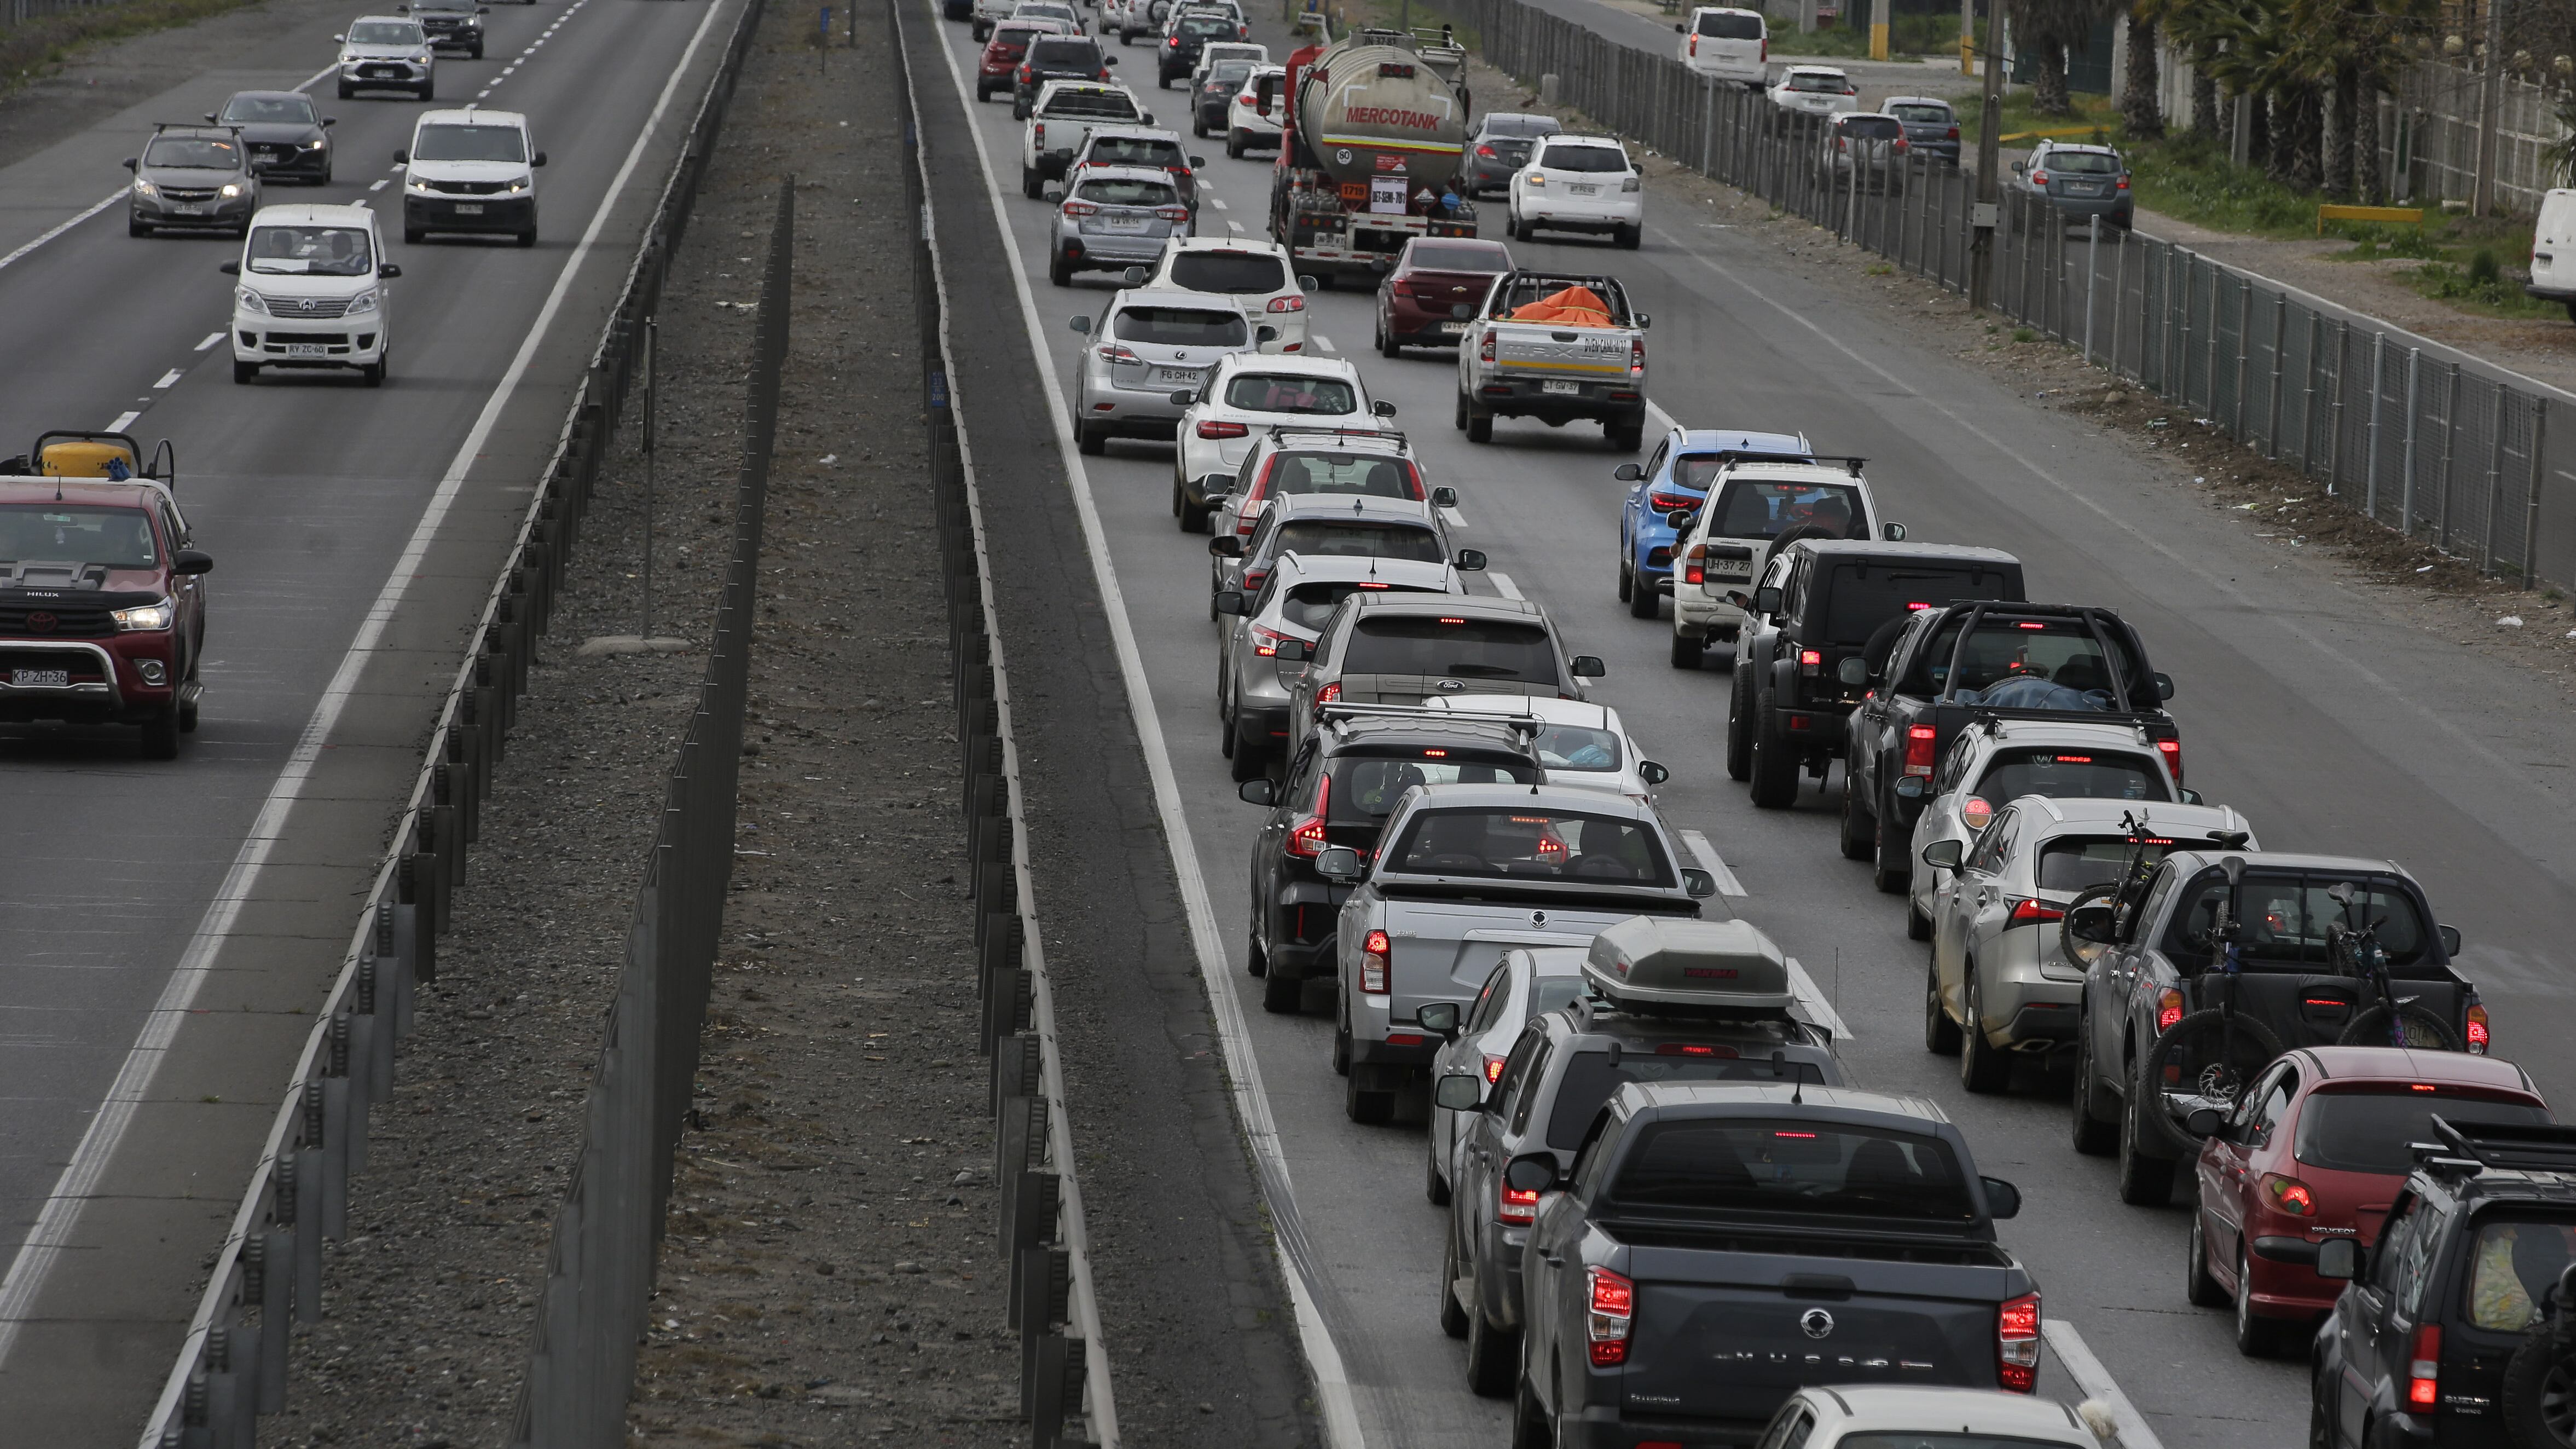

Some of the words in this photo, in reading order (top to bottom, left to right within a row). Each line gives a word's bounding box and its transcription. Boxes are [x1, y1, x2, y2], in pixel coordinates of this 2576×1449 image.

[1346, 106, 1440, 131] MERCOTANK
[1339, 150, 1350, 160] 80
[1344, 186, 1364, 196] 1719
[1684, 968, 1738, 978] YAKIMA
[2311, 1226, 2357, 1234] PEUGEOT
